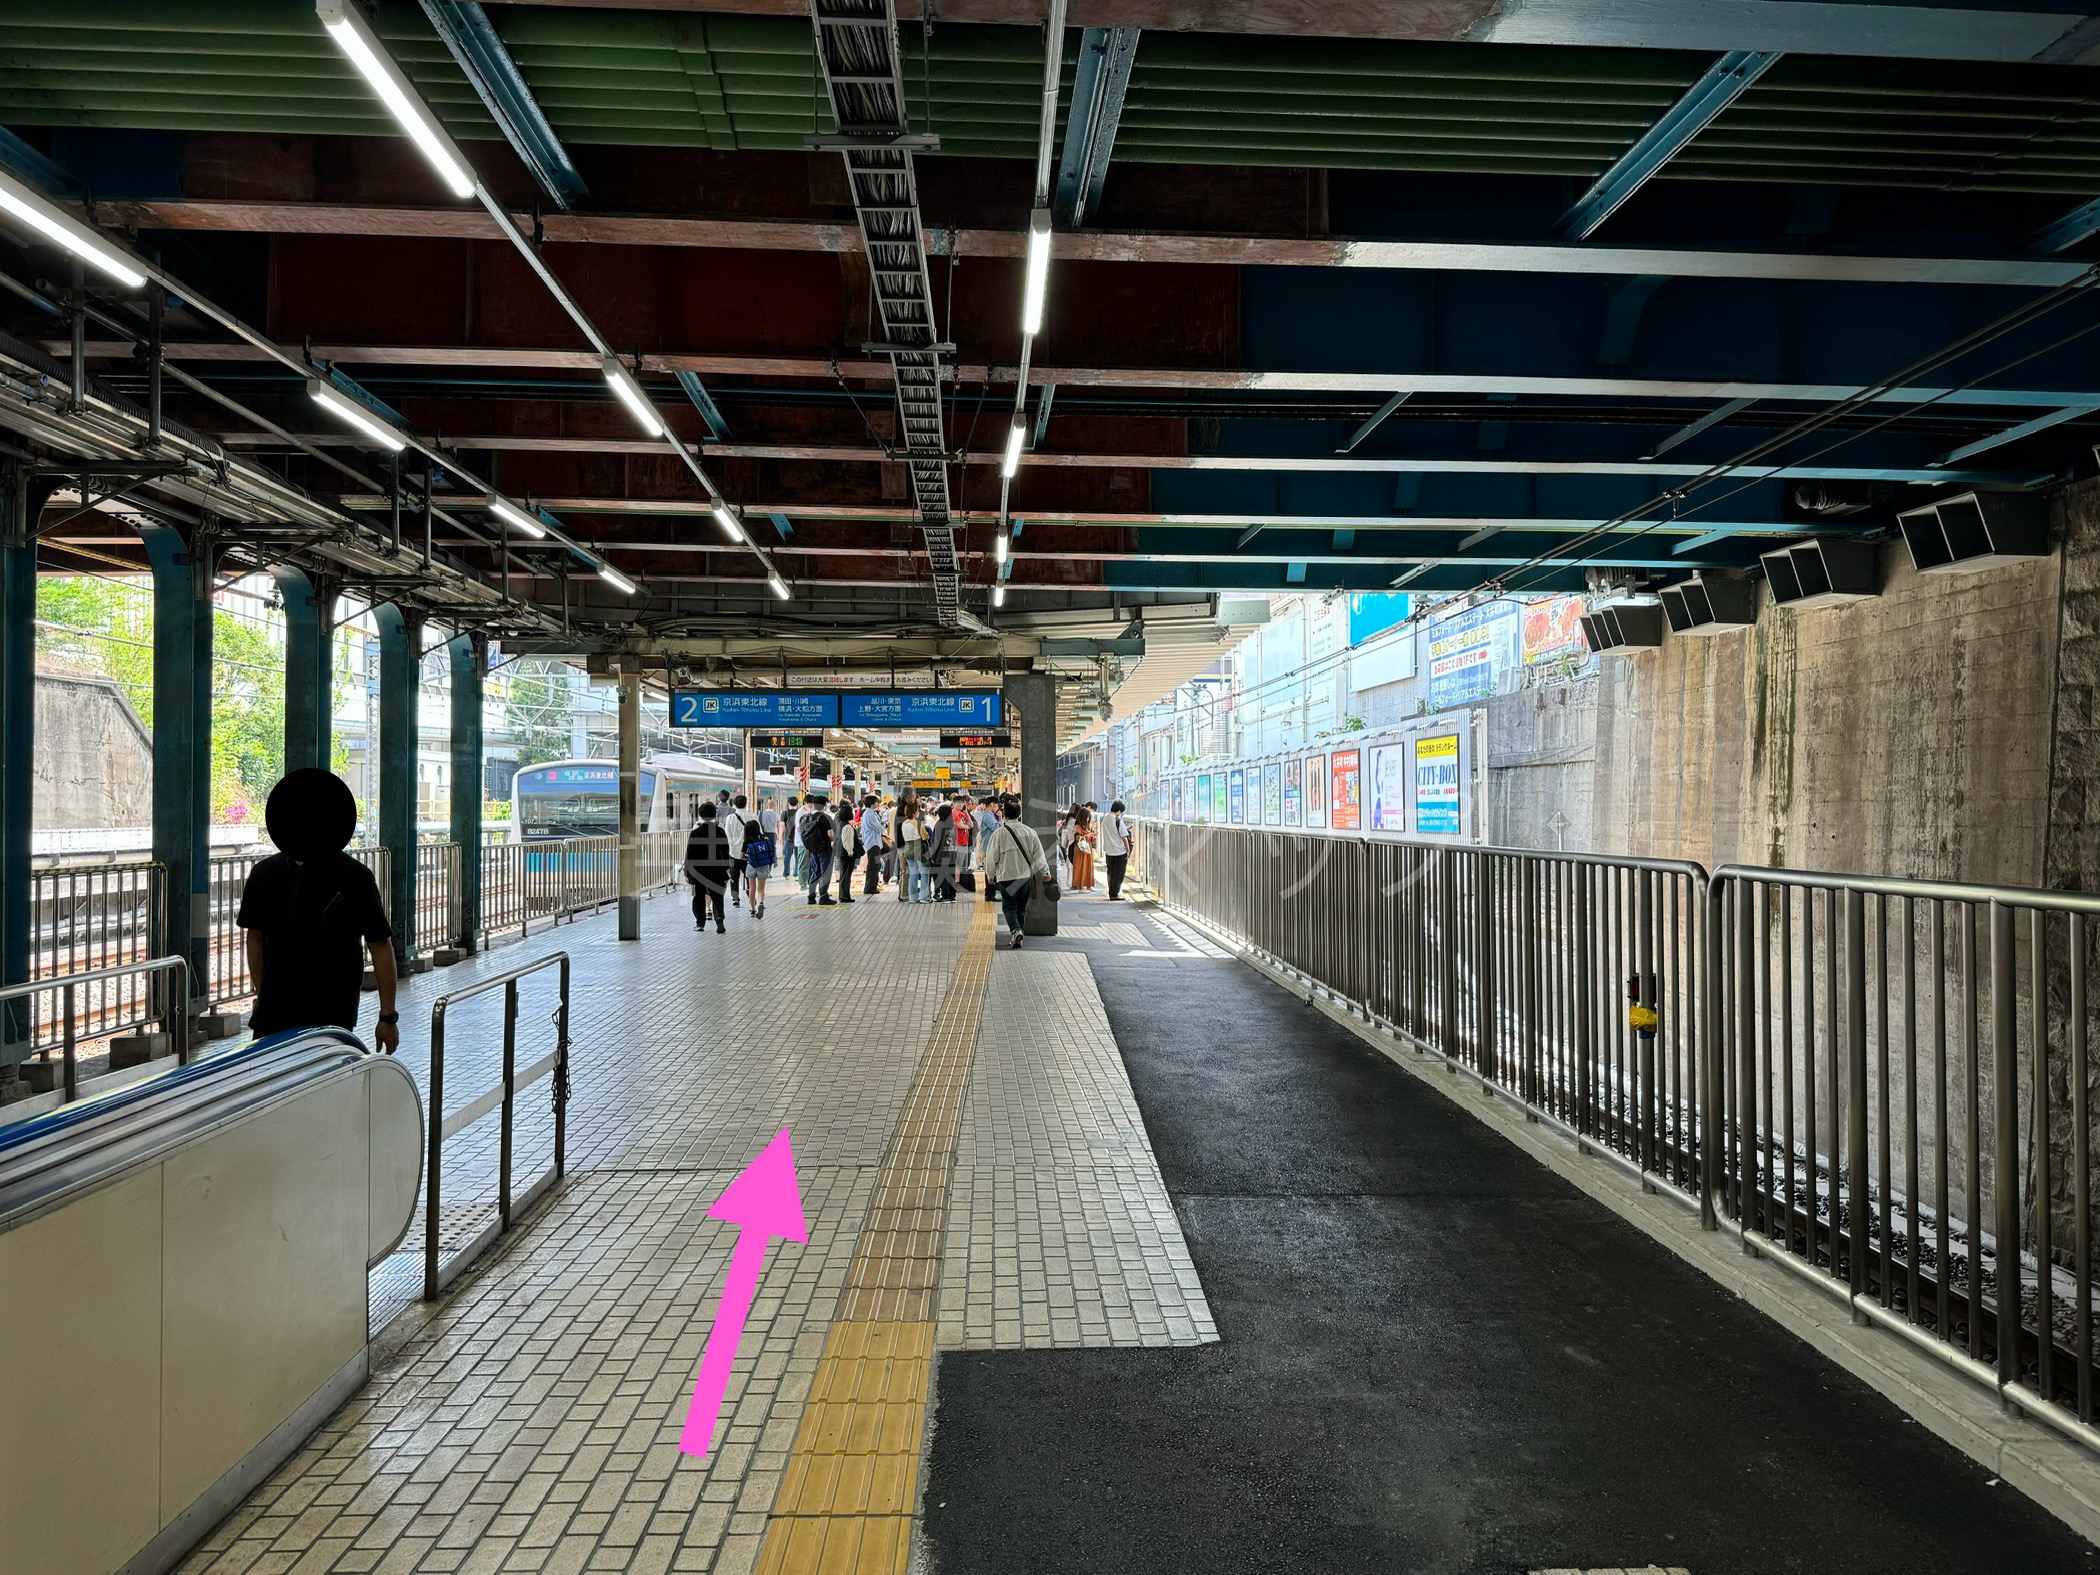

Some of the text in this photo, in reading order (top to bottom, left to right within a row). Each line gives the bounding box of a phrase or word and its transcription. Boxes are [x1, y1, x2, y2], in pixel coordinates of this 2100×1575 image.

[859, 676, 933, 684] ホーム中程まお進みください
[706, 701, 716, 709] JK
[722, 697, 768, 707] 京浜東北線
[871, 697, 902, 705] 品川・東京
[911, 697, 955, 707] 京浜東北線
[961, 701, 972, 709] JK
[680, 696, 698, 723] 2
[980, 697, 991, 722] 1
